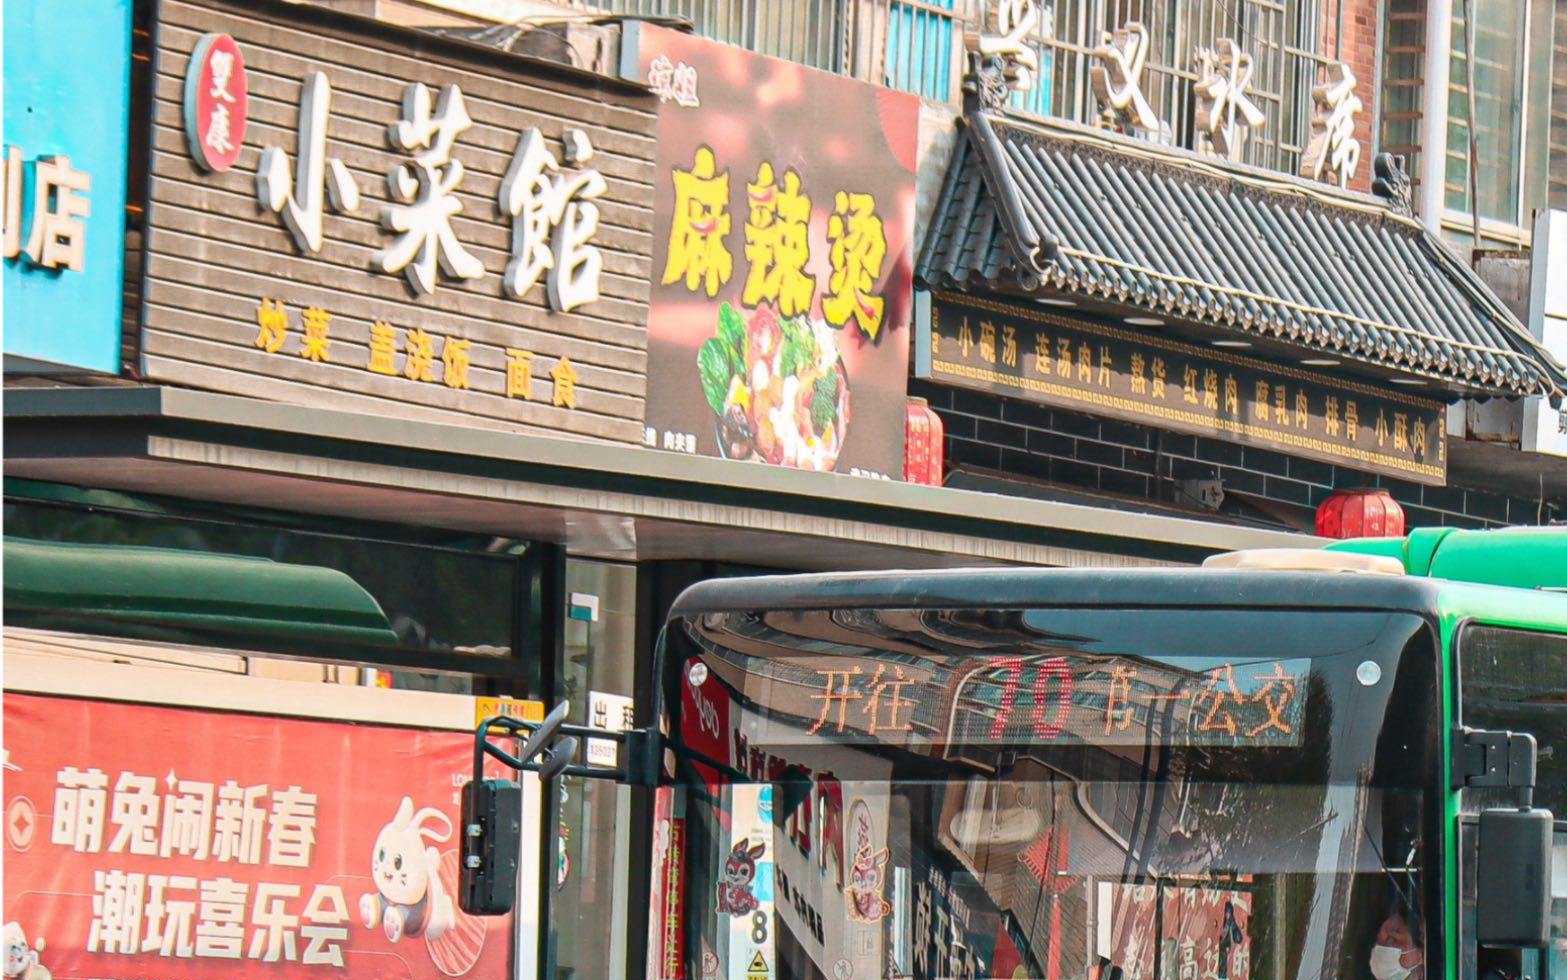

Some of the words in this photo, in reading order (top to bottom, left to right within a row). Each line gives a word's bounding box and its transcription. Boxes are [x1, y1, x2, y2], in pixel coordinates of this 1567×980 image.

[661, 145, 888, 345] 麻辣烫
[255, 297, 331, 361] 炒菜
[368, 320, 470, 389] 盖浇饭
[506, 347, 577, 409] 面食
[957, 315, 1017, 368] 小碗汤
[1034, 332, 1112, 389] 连汤肉片
[1184, 364, 1238, 416] 红烧肉
[1255, 379, 1308, 431] 腐乳肉
[1325, 394, 1358, 442] 排骨
[1376, 407, 1426, 457] 小酥肉
[806, 664, 916, 736] 开往
[51, 766, 318, 867] 萌兔闹新春
[87, 870, 350, 967] 潮玩喜乐会
